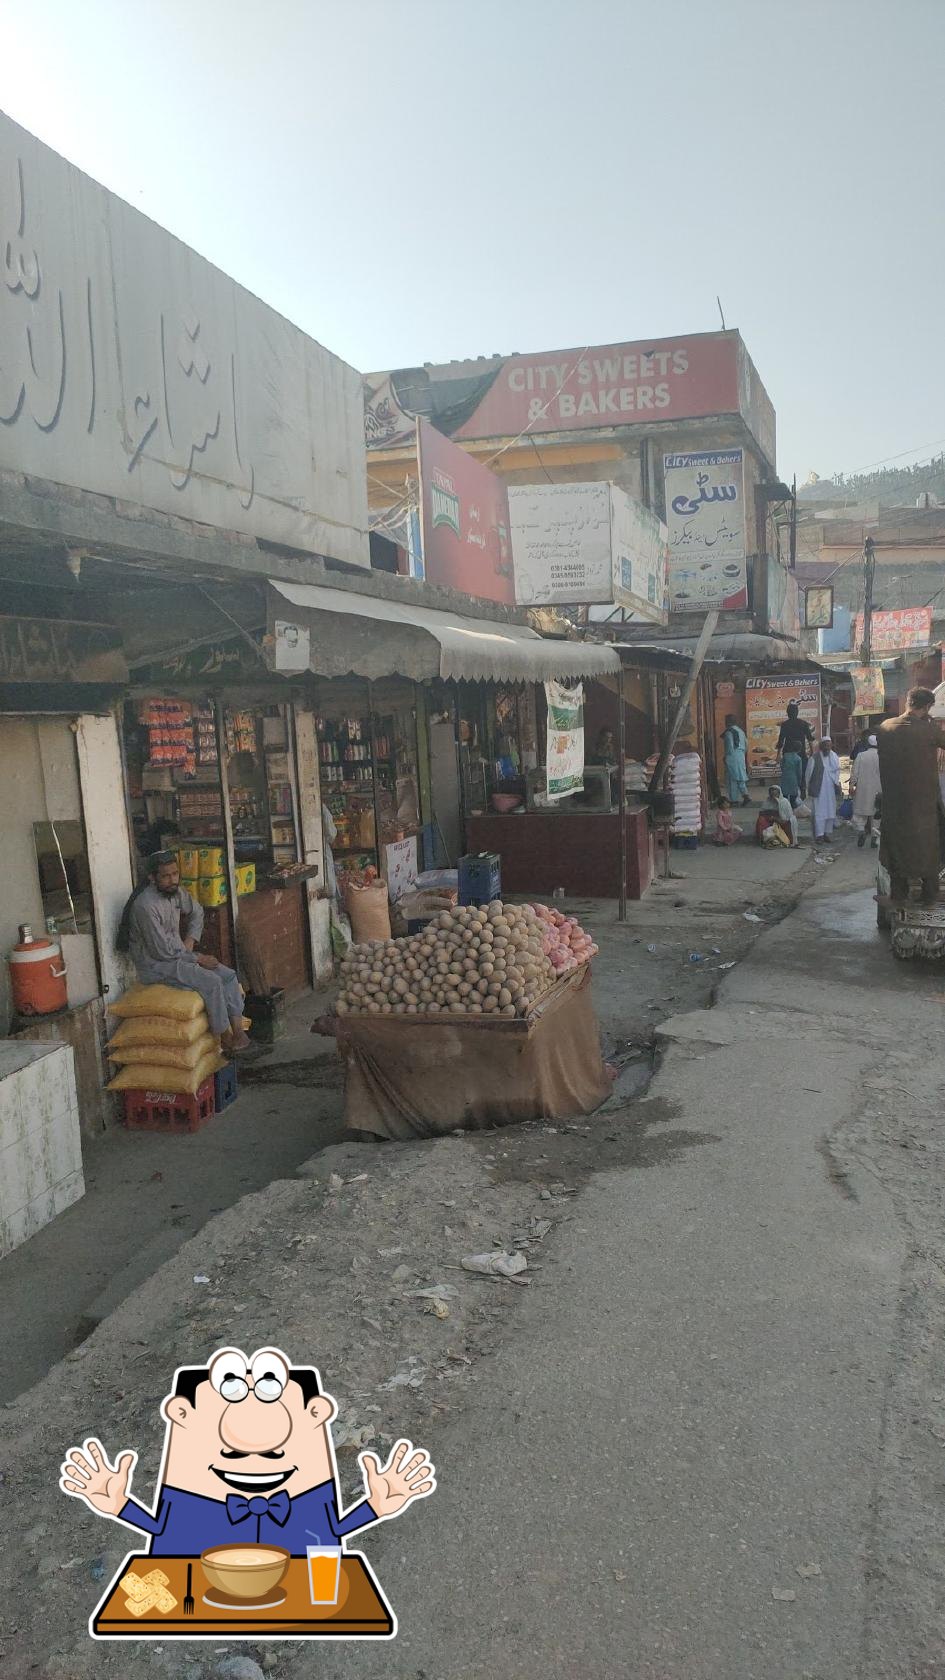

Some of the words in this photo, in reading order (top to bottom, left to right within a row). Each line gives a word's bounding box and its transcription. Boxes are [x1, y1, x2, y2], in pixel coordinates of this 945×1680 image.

[508, 362, 568, 392] CITY
[577, 350, 689, 386] SWEETS
[528, 397, 548, 421] &
[559, 383, 671, 418] BAKERS
[671, 471, 736, 515] سٹی
